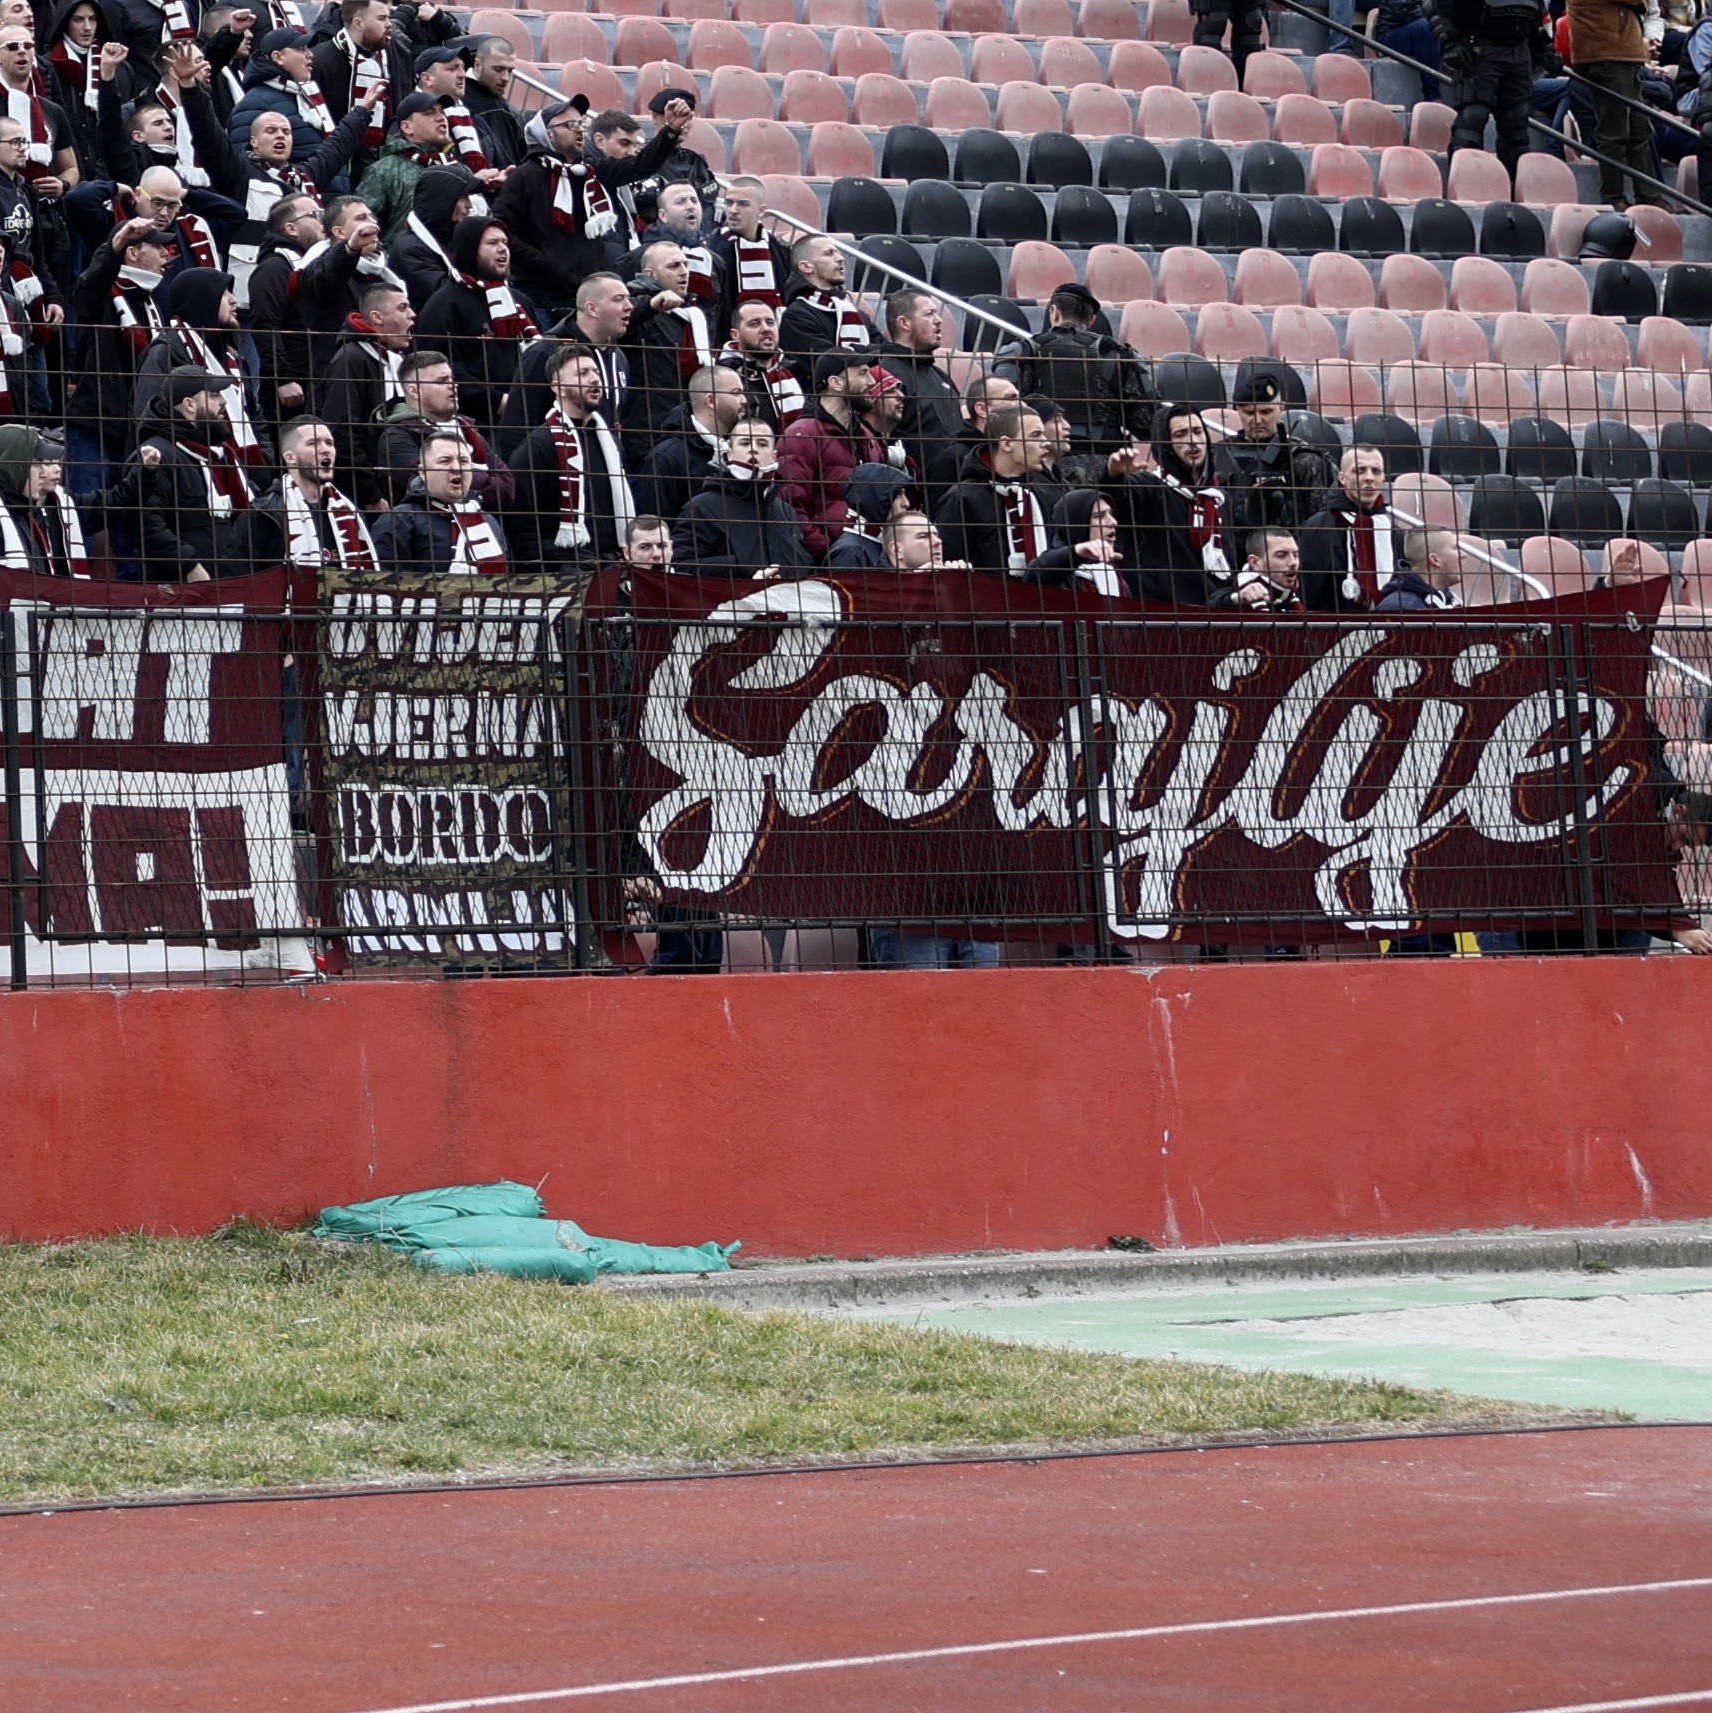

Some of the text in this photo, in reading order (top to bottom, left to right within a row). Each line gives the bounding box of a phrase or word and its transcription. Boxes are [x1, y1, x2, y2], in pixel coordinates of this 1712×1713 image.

[328, 591, 574, 665] UVIJEK
[324, 689, 566, 761] VJERNA
[637, 577, 1647, 941] Sarajlije
[337, 783, 553, 865] BORDO
[343, 888, 592, 955] ARMIJA
